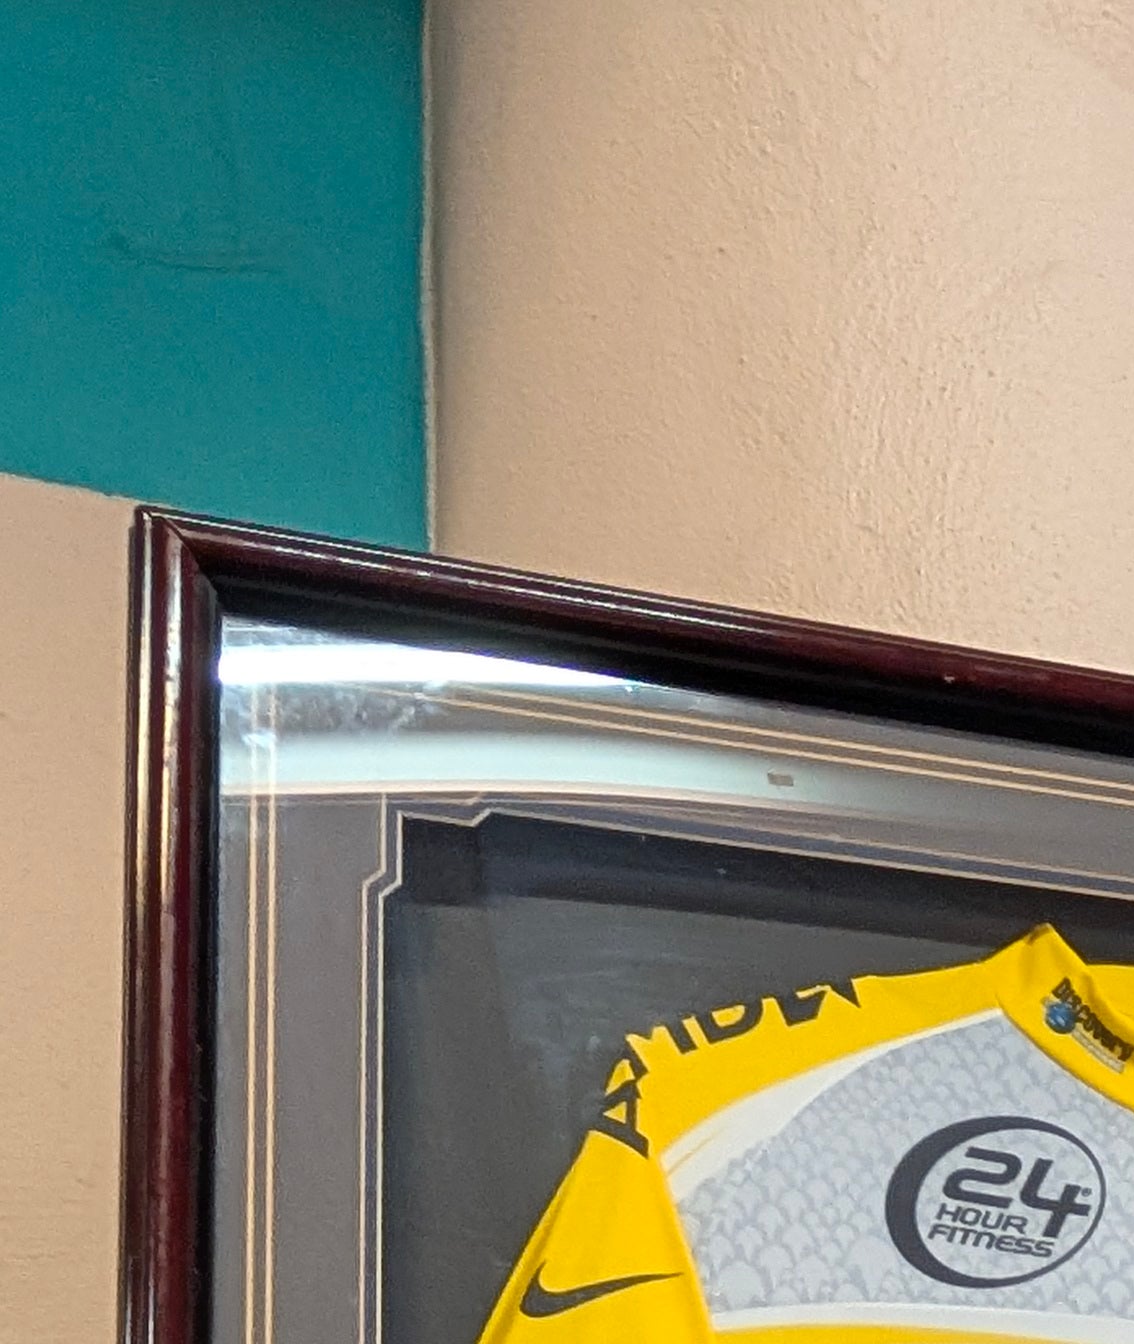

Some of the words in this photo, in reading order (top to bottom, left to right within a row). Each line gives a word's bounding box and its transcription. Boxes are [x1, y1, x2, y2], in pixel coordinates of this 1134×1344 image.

[943, 1146, 1092, 1239] 24
[935, 1202, 1029, 1236] HOUR
[927, 1222, 1056, 1259] FITNESS
